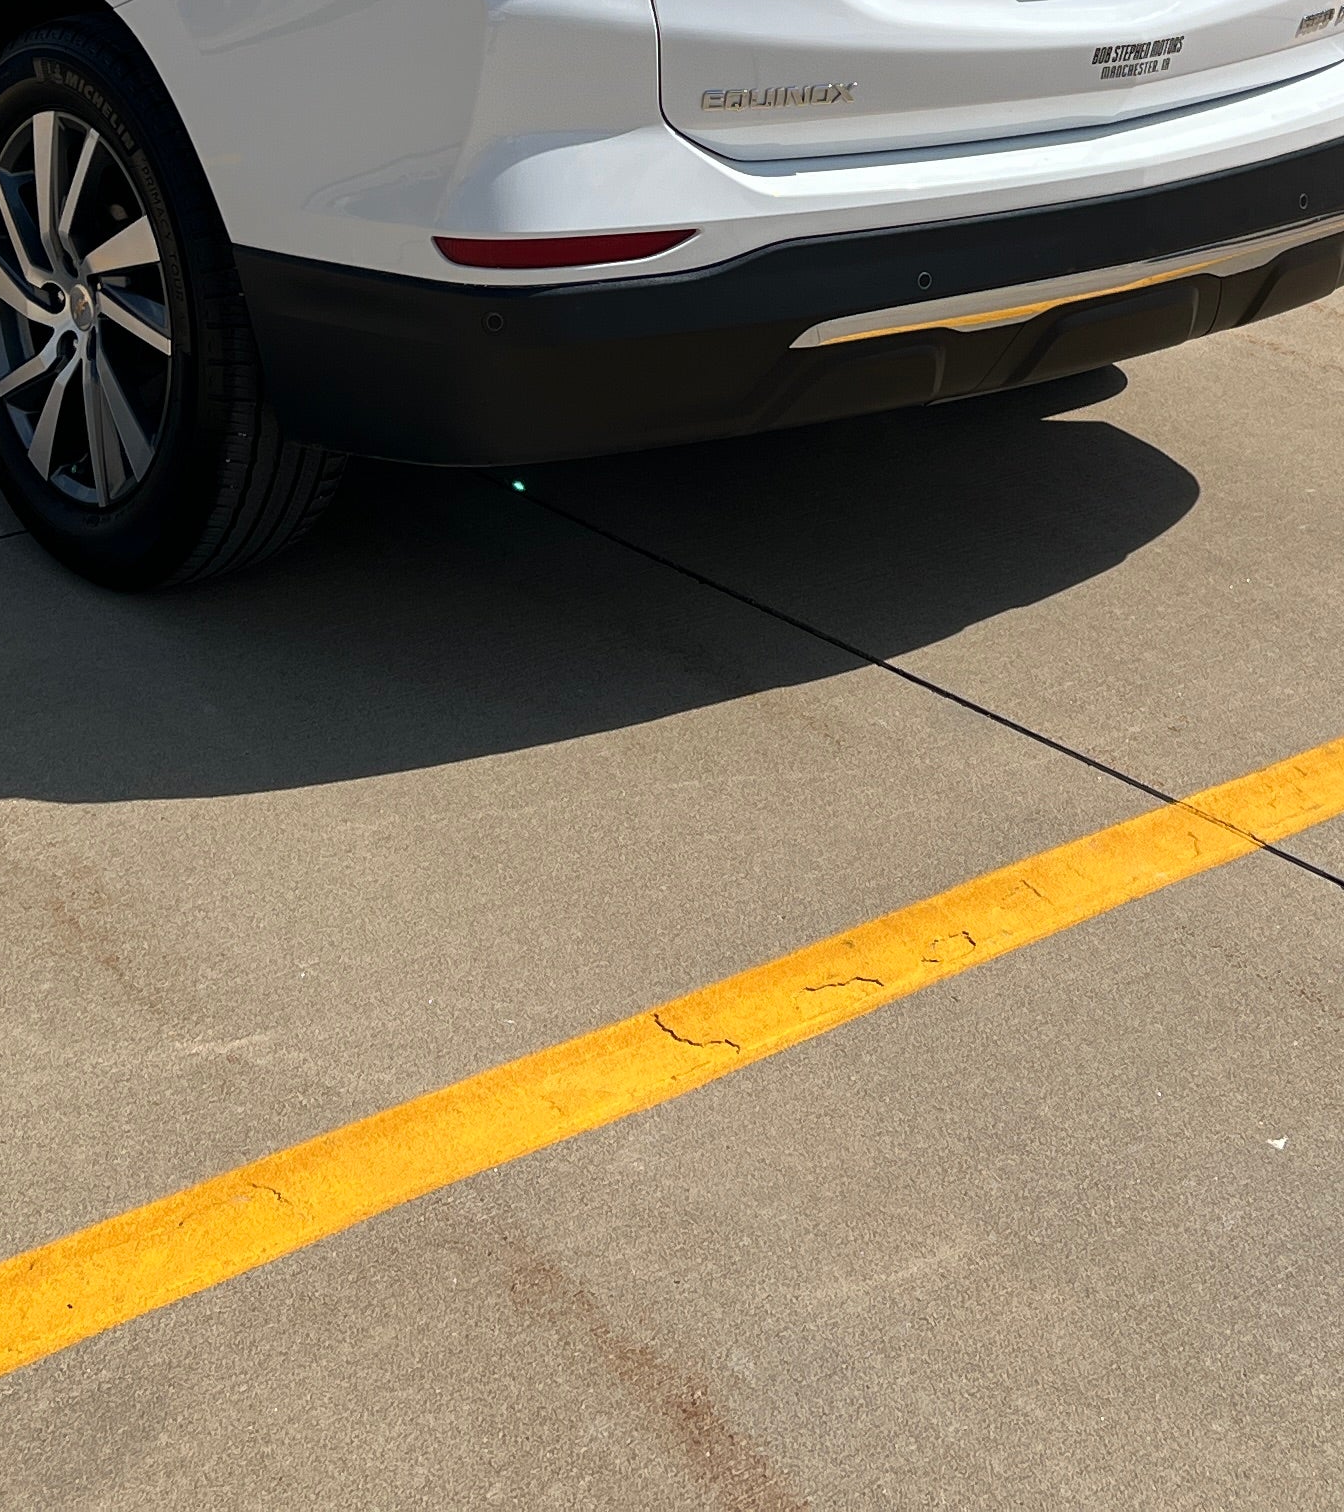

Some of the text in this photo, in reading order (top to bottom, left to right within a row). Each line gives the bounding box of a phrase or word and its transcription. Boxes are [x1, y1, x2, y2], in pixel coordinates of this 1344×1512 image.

[1092, 35, 1185, 65] BOB STEPHEN MOTORS
[701, 81, 858, 111] EQUINOX
[64, 70, 136, 153] MICHELIN
